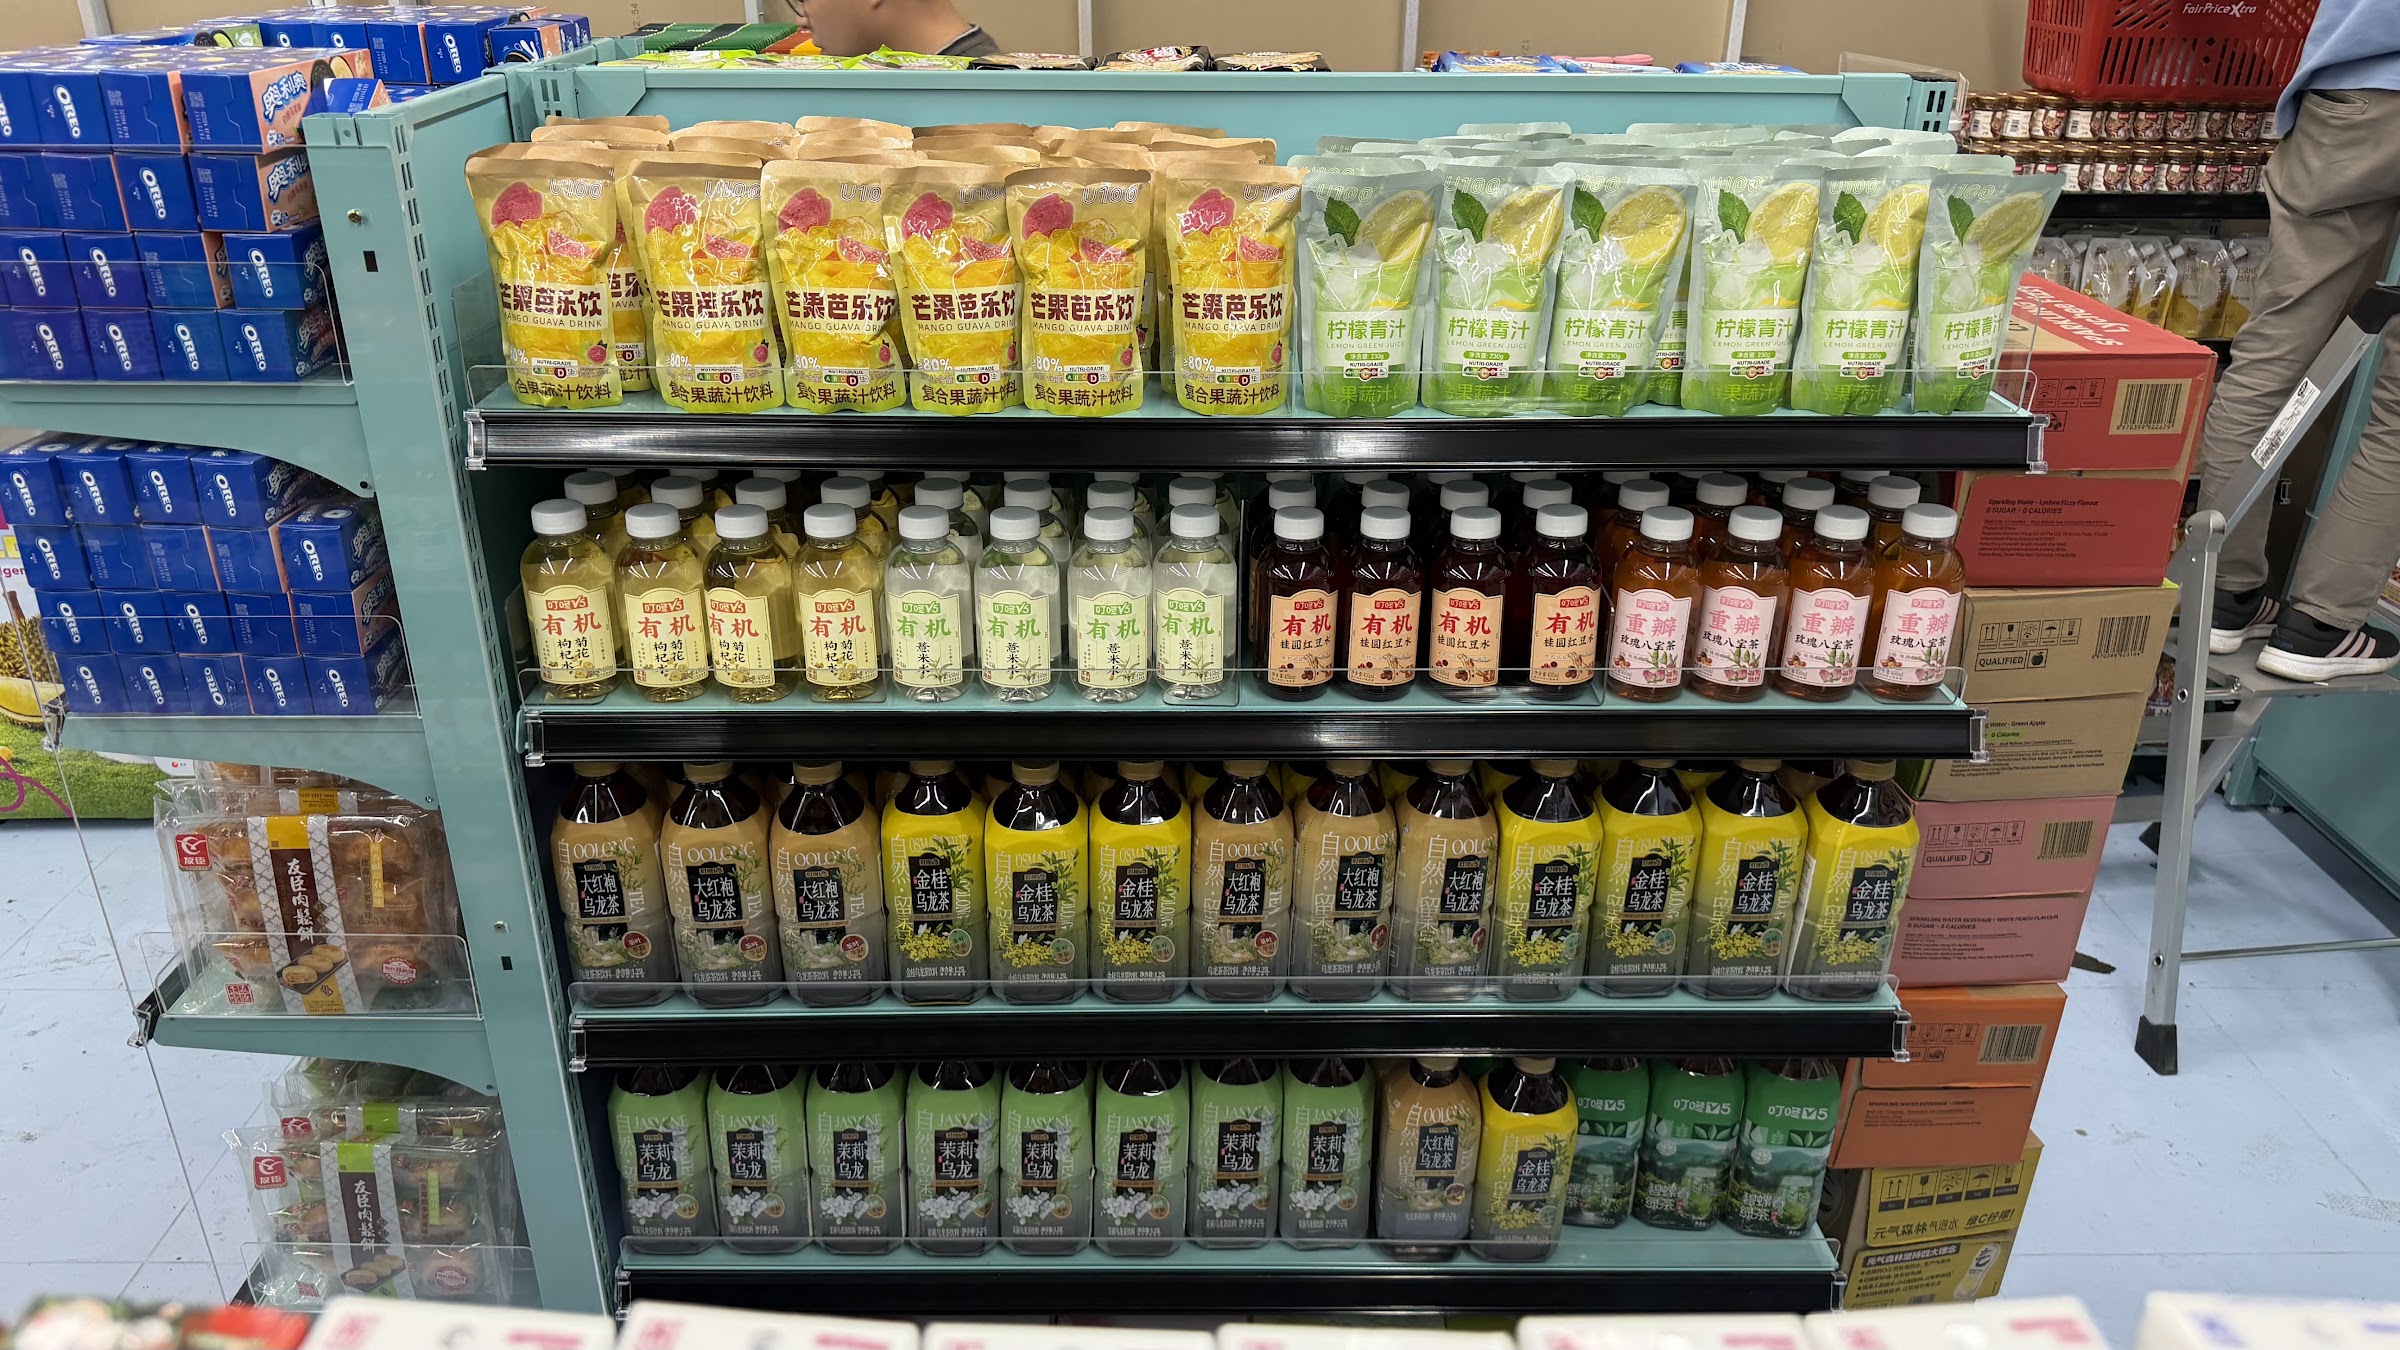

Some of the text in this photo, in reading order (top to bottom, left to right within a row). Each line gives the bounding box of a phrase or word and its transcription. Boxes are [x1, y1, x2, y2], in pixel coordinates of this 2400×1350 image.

[443, 33, 463, 74] OREO
[53, 85, 81, 139] OREO
[140, 167, 166, 219] OREO
[90, 247, 117, 297] OREO
[532, 315, 602, 328] GUAVA DRINK
[696, 318, 765, 330] GUAVA DRINK
[790, 320, 860, 332] MANGO GUAVA
[1032, 322, 1103, 333] MANGO GUAVA
[1185, 322, 1219, 332] MANGO
[1327, 318, 1407, 340] 柠檬青汁
[1448, 318, 1530, 341] 柠檬青汁
[1564, 318, 1645, 341] 柠檬青汁
[1714, 318, 1793, 340] 柠檬青汁
[1825, 318, 1905, 340] 柠檬青汁
[36, 323, 64, 372] OREO
[106, 323, 132, 372] OREO
[175, 323, 199, 372] OREO
[242, 323, 267, 372] OREO
[1356, 341, 1384, 349] GREEN
[1447, 340, 1474, 348] LEMON
[1477, 341, 1505, 349] GREEN
[1562, 340, 1592, 348] LEMON
[1594, 341, 1621, 349] GREEN
[1034, 382, 1134, 406] 复合果蔬汁饮料
[148, 469, 173, 514] OREO
[214, 472, 237, 518] OREO
[301, 538, 324, 582] OREO
[121, 601, 144, 644] OREO
[541, 612, 601, 636] 有机
[638, 614, 695, 639] 有机
[810, 615, 866, 639] 有机
[897, 616, 951, 639] 有机
[987, 616, 1041, 639] 有机
[1161, 613, 1215, 638] 有机
[1280, 613, 1332, 636] 有机
[1360, 613, 1413, 636] 有机
[1439, 611, 1492, 636] 有机
[1545, 610, 1595, 634] 有机
[1979, 656, 2024, 666] QUALIFIED
[264, 667, 286, 707] OREO
[326, 668, 349, 708] OREO
[1996, 730, 2020, 738] Calories
[2011, 719, 2028, 727] Green
[2030, 719, 2047, 728] Apple
[183, 856, 205, 866] 友臣
[1926, 855, 1967, 863] QUALIFIED
[580, 873, 618, 894] 大红袍
[694, 877, 734, 898] 大红袍
[915, 868, 948, 890] 金桂
[1342, 867, 1380, 888] 大红袍
[1535, 875, 1573, 897] 金桂
[1739, 870, 1774, 892] 金桂
[799, 879, 838, 900] 大红袍
[1016, 883, 1054, 904] 金桂
[1339, 889, 1377, 909] 乌龙茶
[583, 895, 620, 916] 乌龙茶
[697, 899, 737, 921] 乌龙茶
[802, 900, 839, 921] 乌龙茶
[916, 891, 949, 912] 乌龙茶
[1533, 897, 1573, 917] 乌龙茶
[1735, 892, 1773, 913] 乌龙茶
[1017, 904, 1054, 923] 乌龙茶
[640, 1142, 671, 1161] 茉莉
[837, 1142, 865, 1160] 茉莉
[939, 1140, 974, 1160] 茉莉
[1222, 1133, 1256, 1152] 茉莉
[643, 1162, 672, 1181] 乌龙
[839, 1161, 864, 1179] 乌龙
[940, 1160, 973, 1179] 乌龙
[1222, 1153, 1254, 1171] 乌龙
[1873, 1222, 1927, 1239] 元气森林
